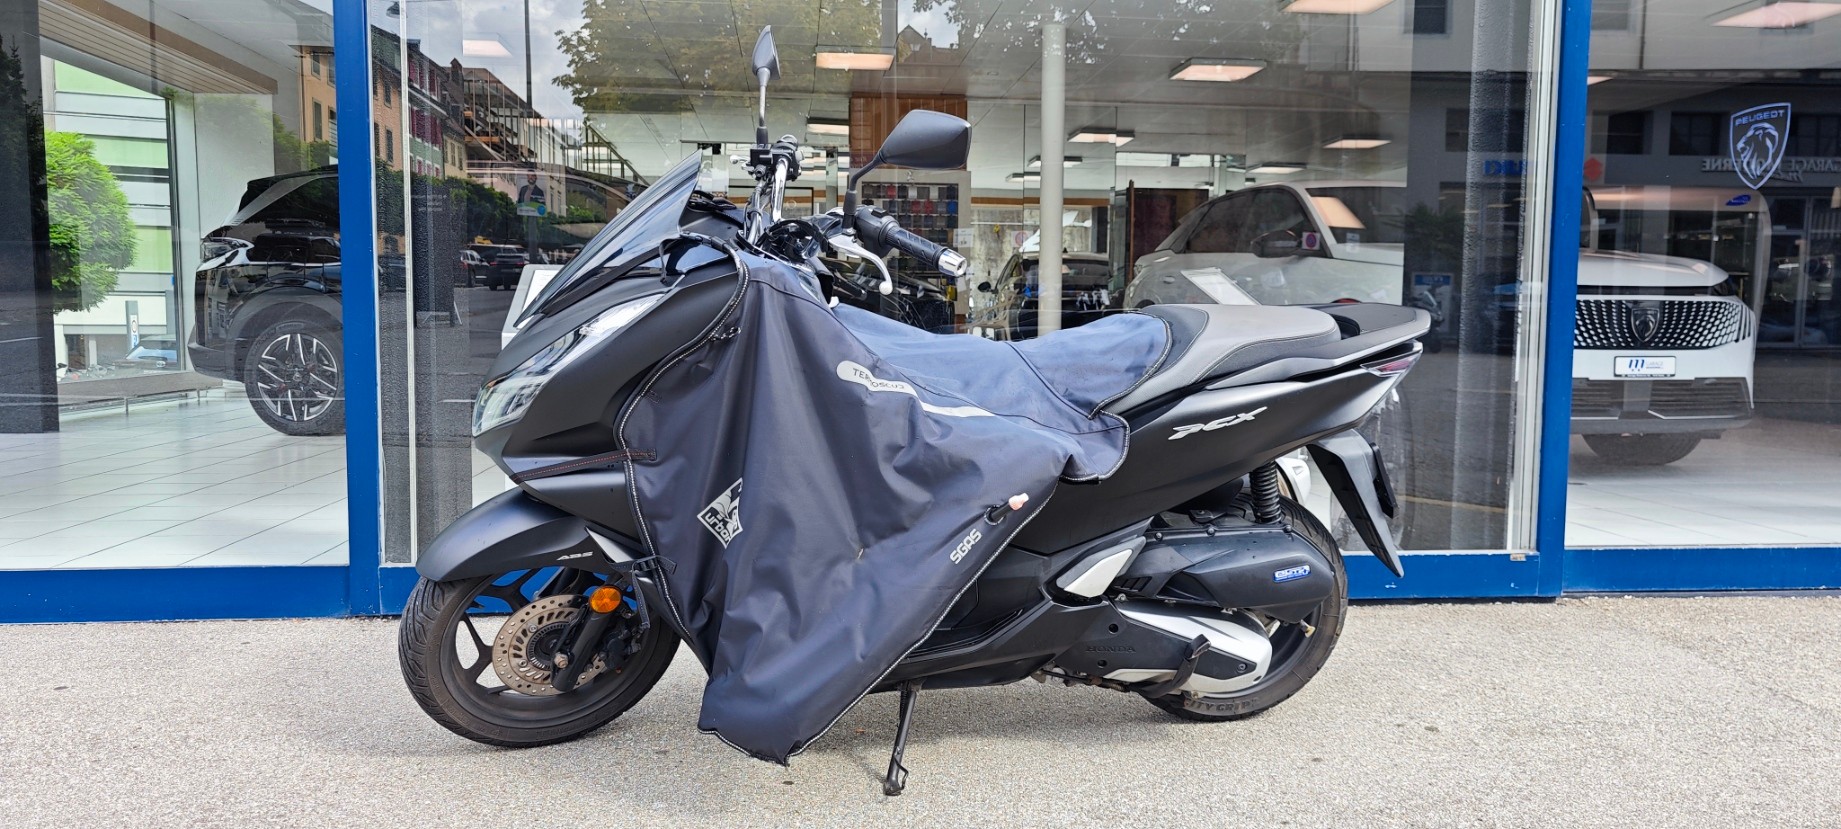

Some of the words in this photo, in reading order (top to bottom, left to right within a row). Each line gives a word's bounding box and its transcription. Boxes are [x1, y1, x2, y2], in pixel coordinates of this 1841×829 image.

[1735, 109, 1785, 126] PEUGEOT
[1167, 406, 1268, 440] PCX
[949, 528, 983, 565] SGAS
[556, 551, 593, 561] ABS
[1085, 645, 1137, 653] HONDA
[1215, 700, 1251, 712] GRIP
